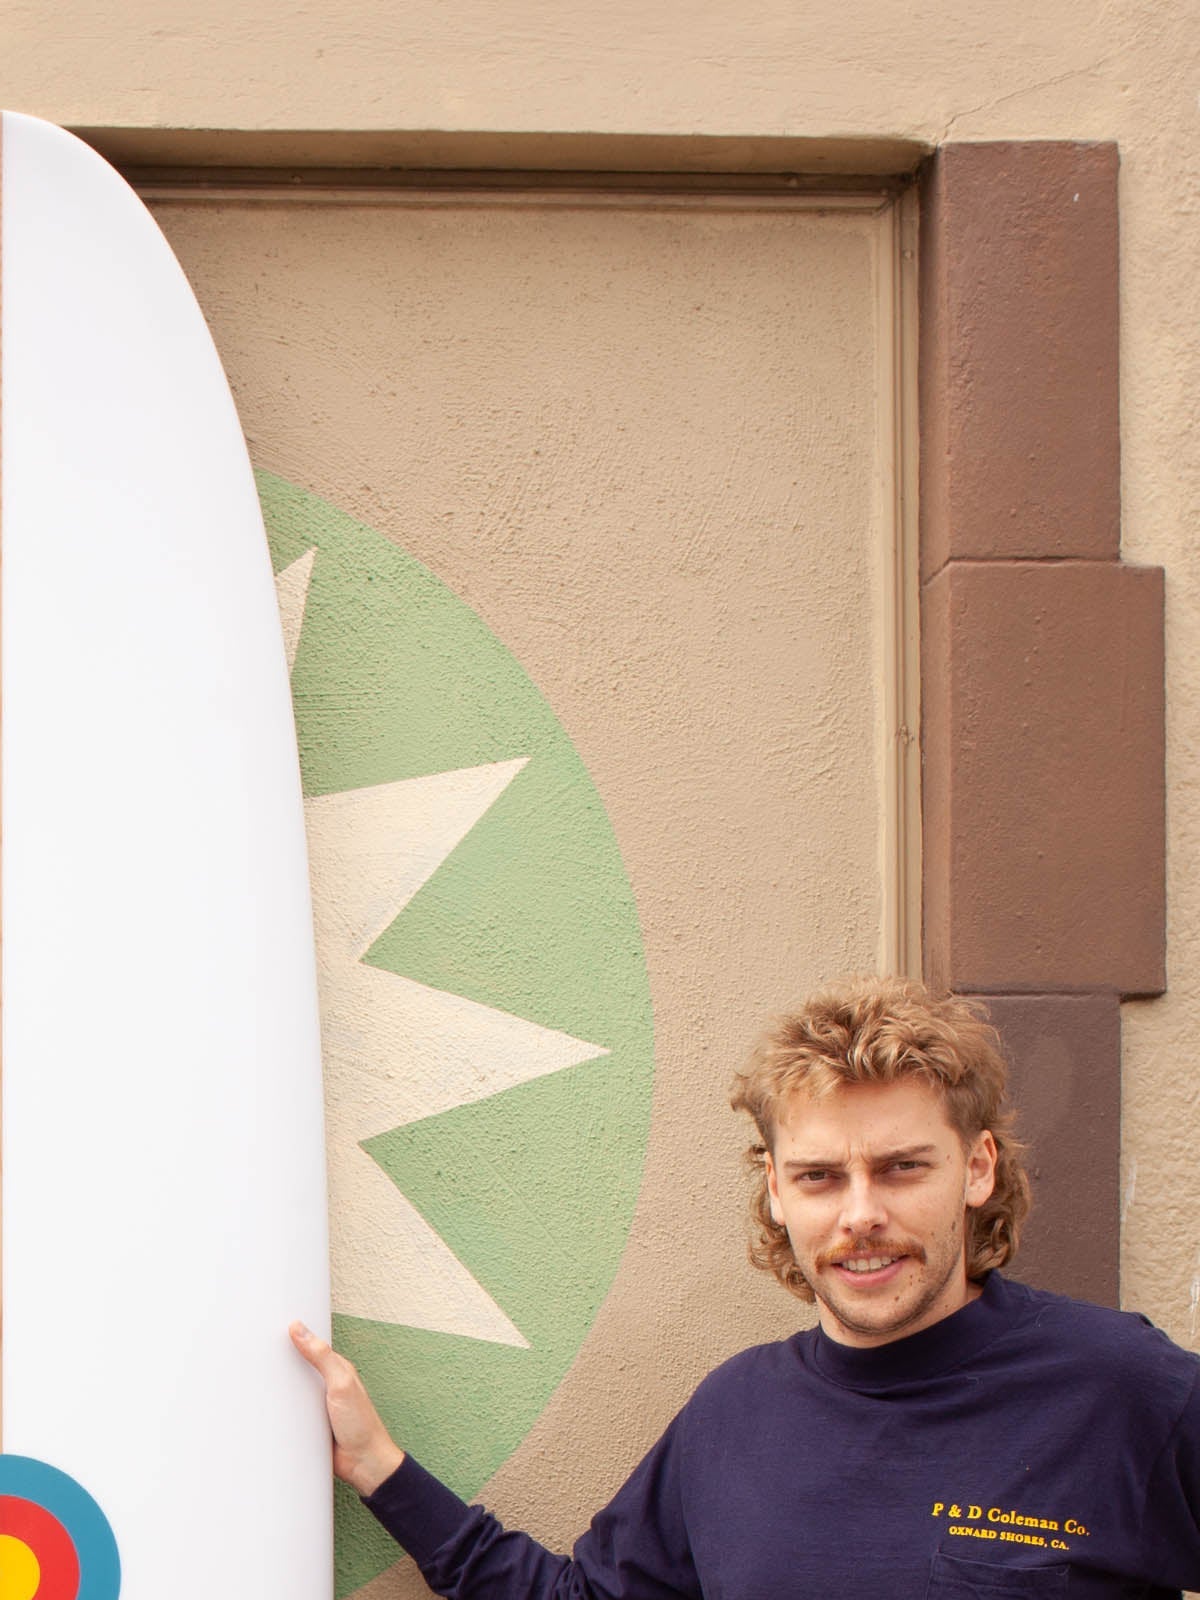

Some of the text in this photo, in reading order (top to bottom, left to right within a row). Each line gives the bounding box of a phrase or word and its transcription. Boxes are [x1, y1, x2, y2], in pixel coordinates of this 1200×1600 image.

[931, 1502, 1091, 1536] P & D Coleman Co.
[949, 1526, 1070, 1551] OXNARD SHORES, CA.
